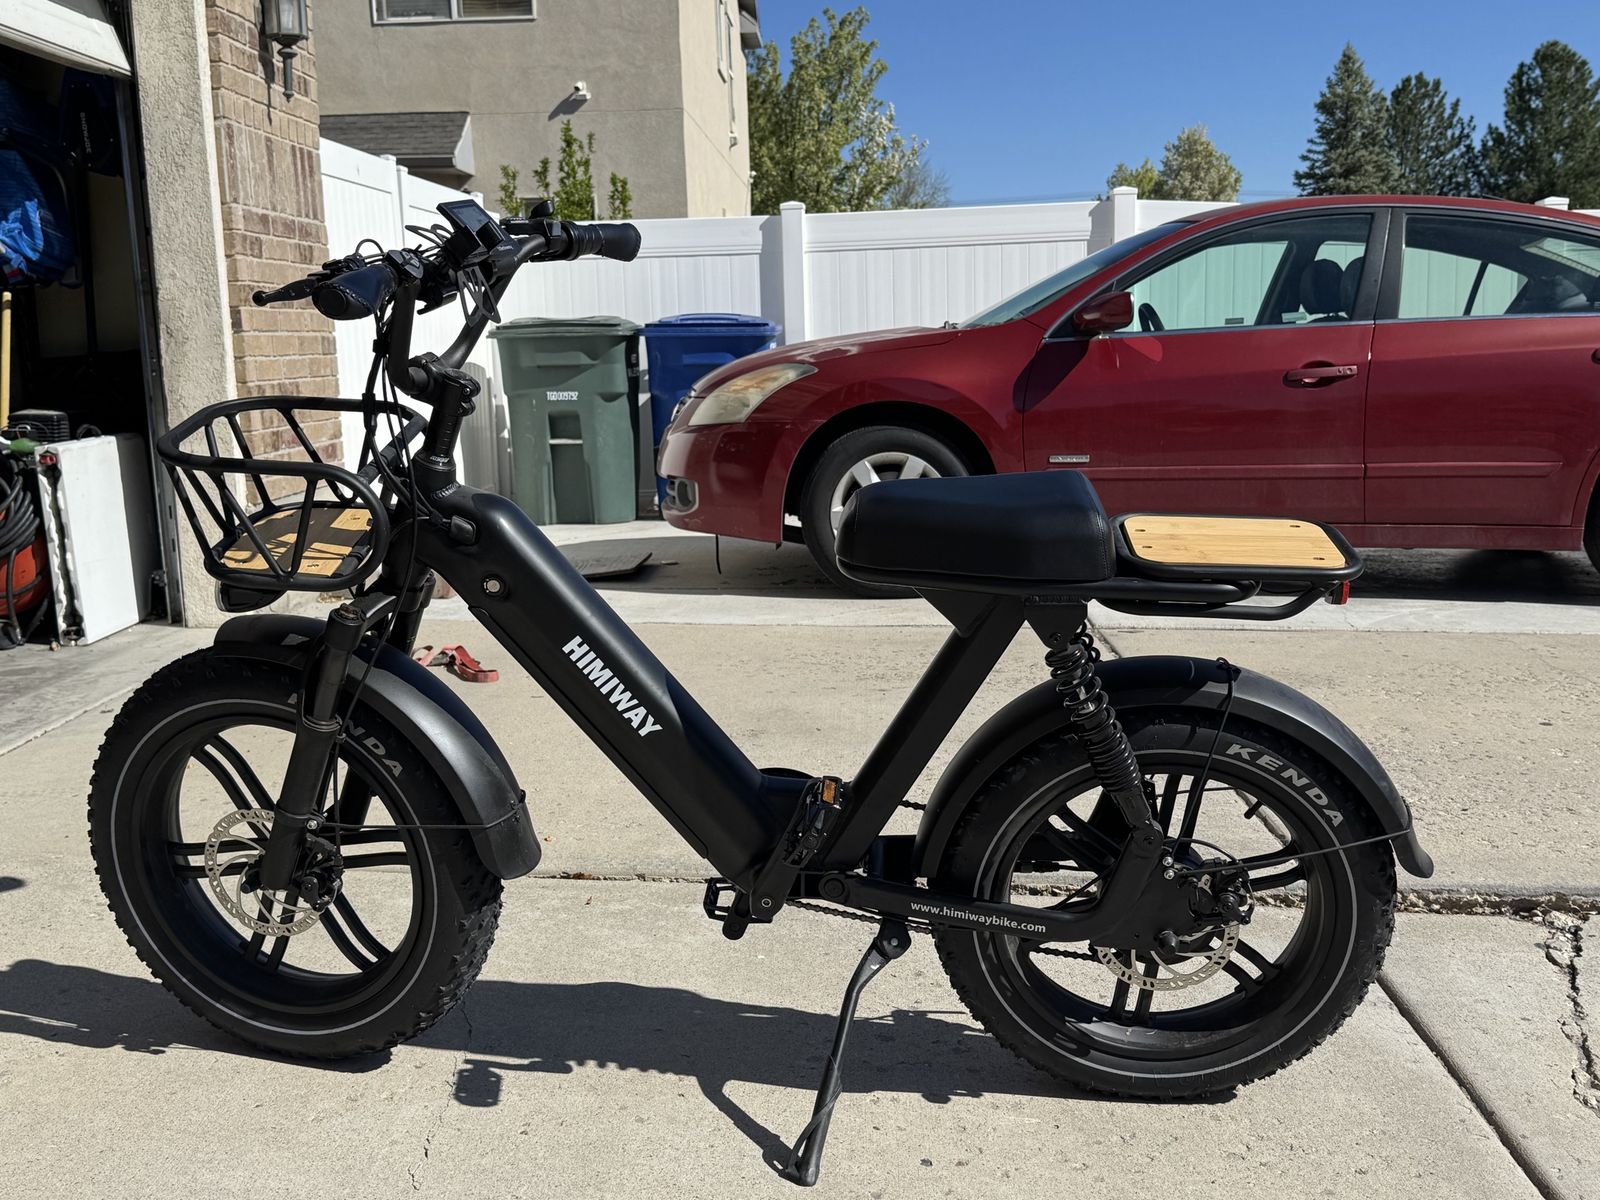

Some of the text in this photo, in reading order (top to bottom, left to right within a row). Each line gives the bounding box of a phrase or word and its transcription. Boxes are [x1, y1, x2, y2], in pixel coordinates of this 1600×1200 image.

[562, 635, 663, 737] HIMIWAY
[1225, 743, 1344, 828] KENDA
[910, 902, 1046, 933] www.himiwaybike.com
